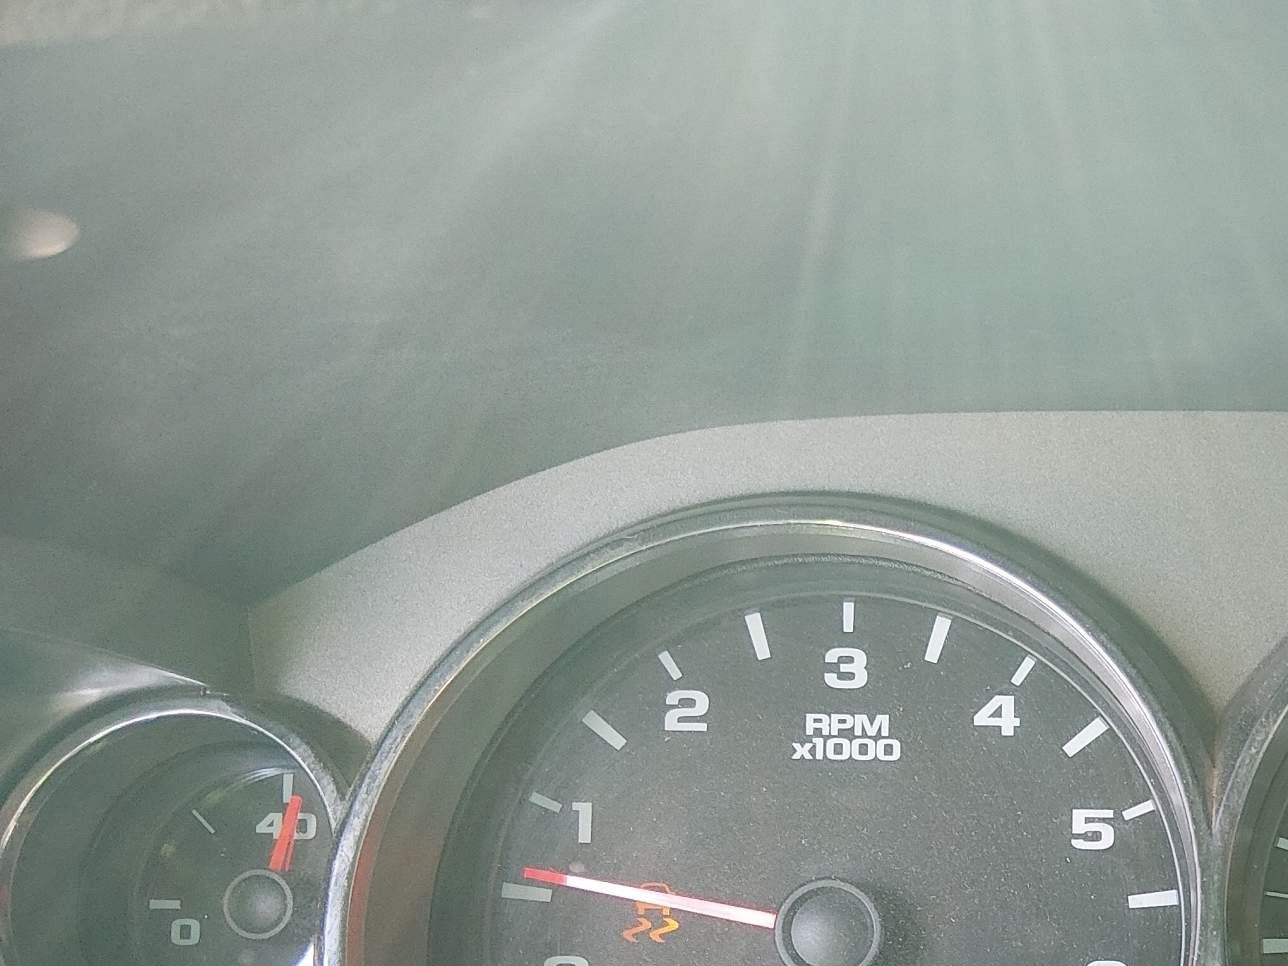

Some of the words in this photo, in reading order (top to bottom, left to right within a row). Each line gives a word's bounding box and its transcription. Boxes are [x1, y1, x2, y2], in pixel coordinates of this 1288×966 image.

[823, 647, 868, 690] 3
[664, 689, 710, 731] 2
[804, 713, 890, 737] RPM
[973, 695, 1020, 736] 4
[792, 738, 900, 762] x1000
[255, 812, 317, 840] 40
[571, 802, 593, 843] 1
[1070, 809, 1115, 850] 5
[170, 919, 200, 946] 0
